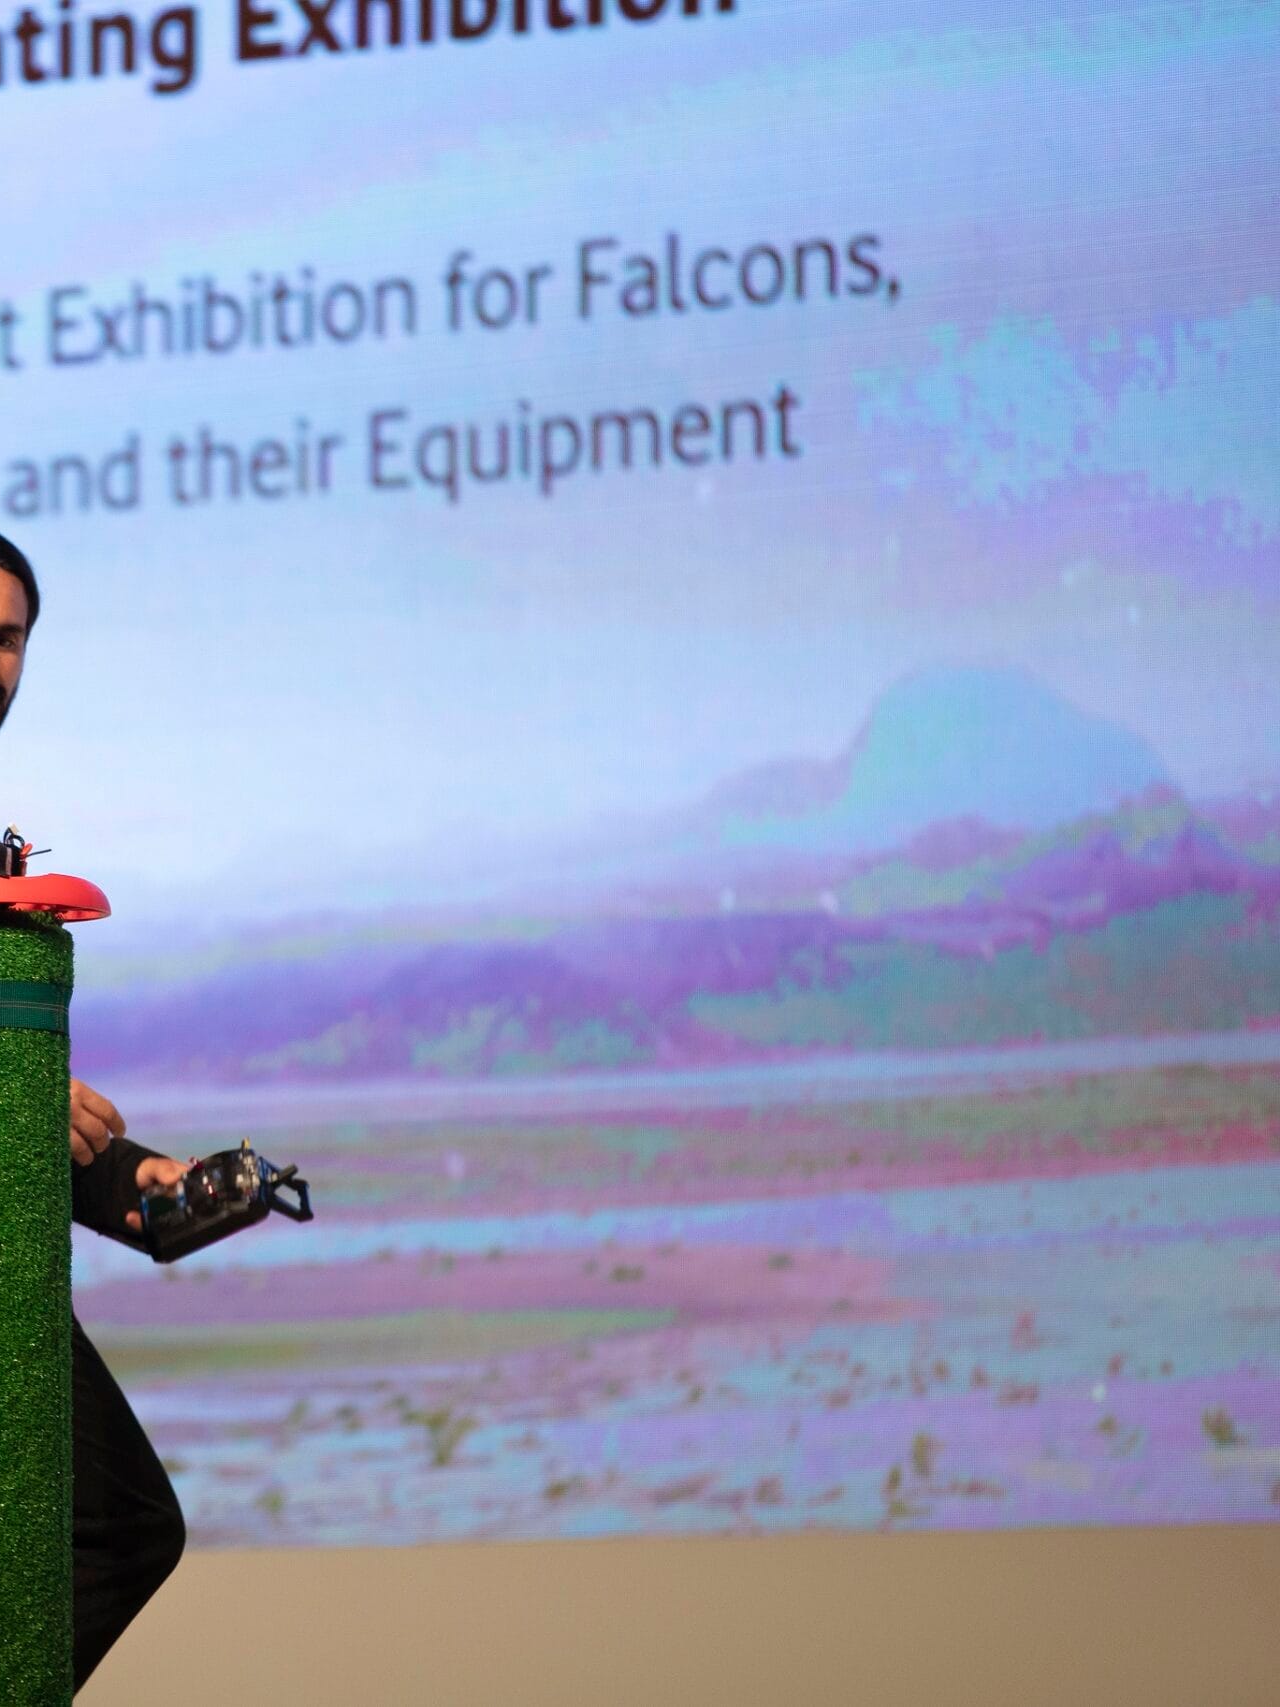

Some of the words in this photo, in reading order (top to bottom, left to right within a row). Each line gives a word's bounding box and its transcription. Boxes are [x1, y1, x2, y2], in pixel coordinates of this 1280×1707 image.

[45, 268, 418, 366] Exhibition
[445, 250, 552, 331] for
[577, 231, 901, 319] Falcons,
[4, 432, 140, 519] and
[166, 416, 341, 506] their
[367, 385, 803, 504] Equipment
